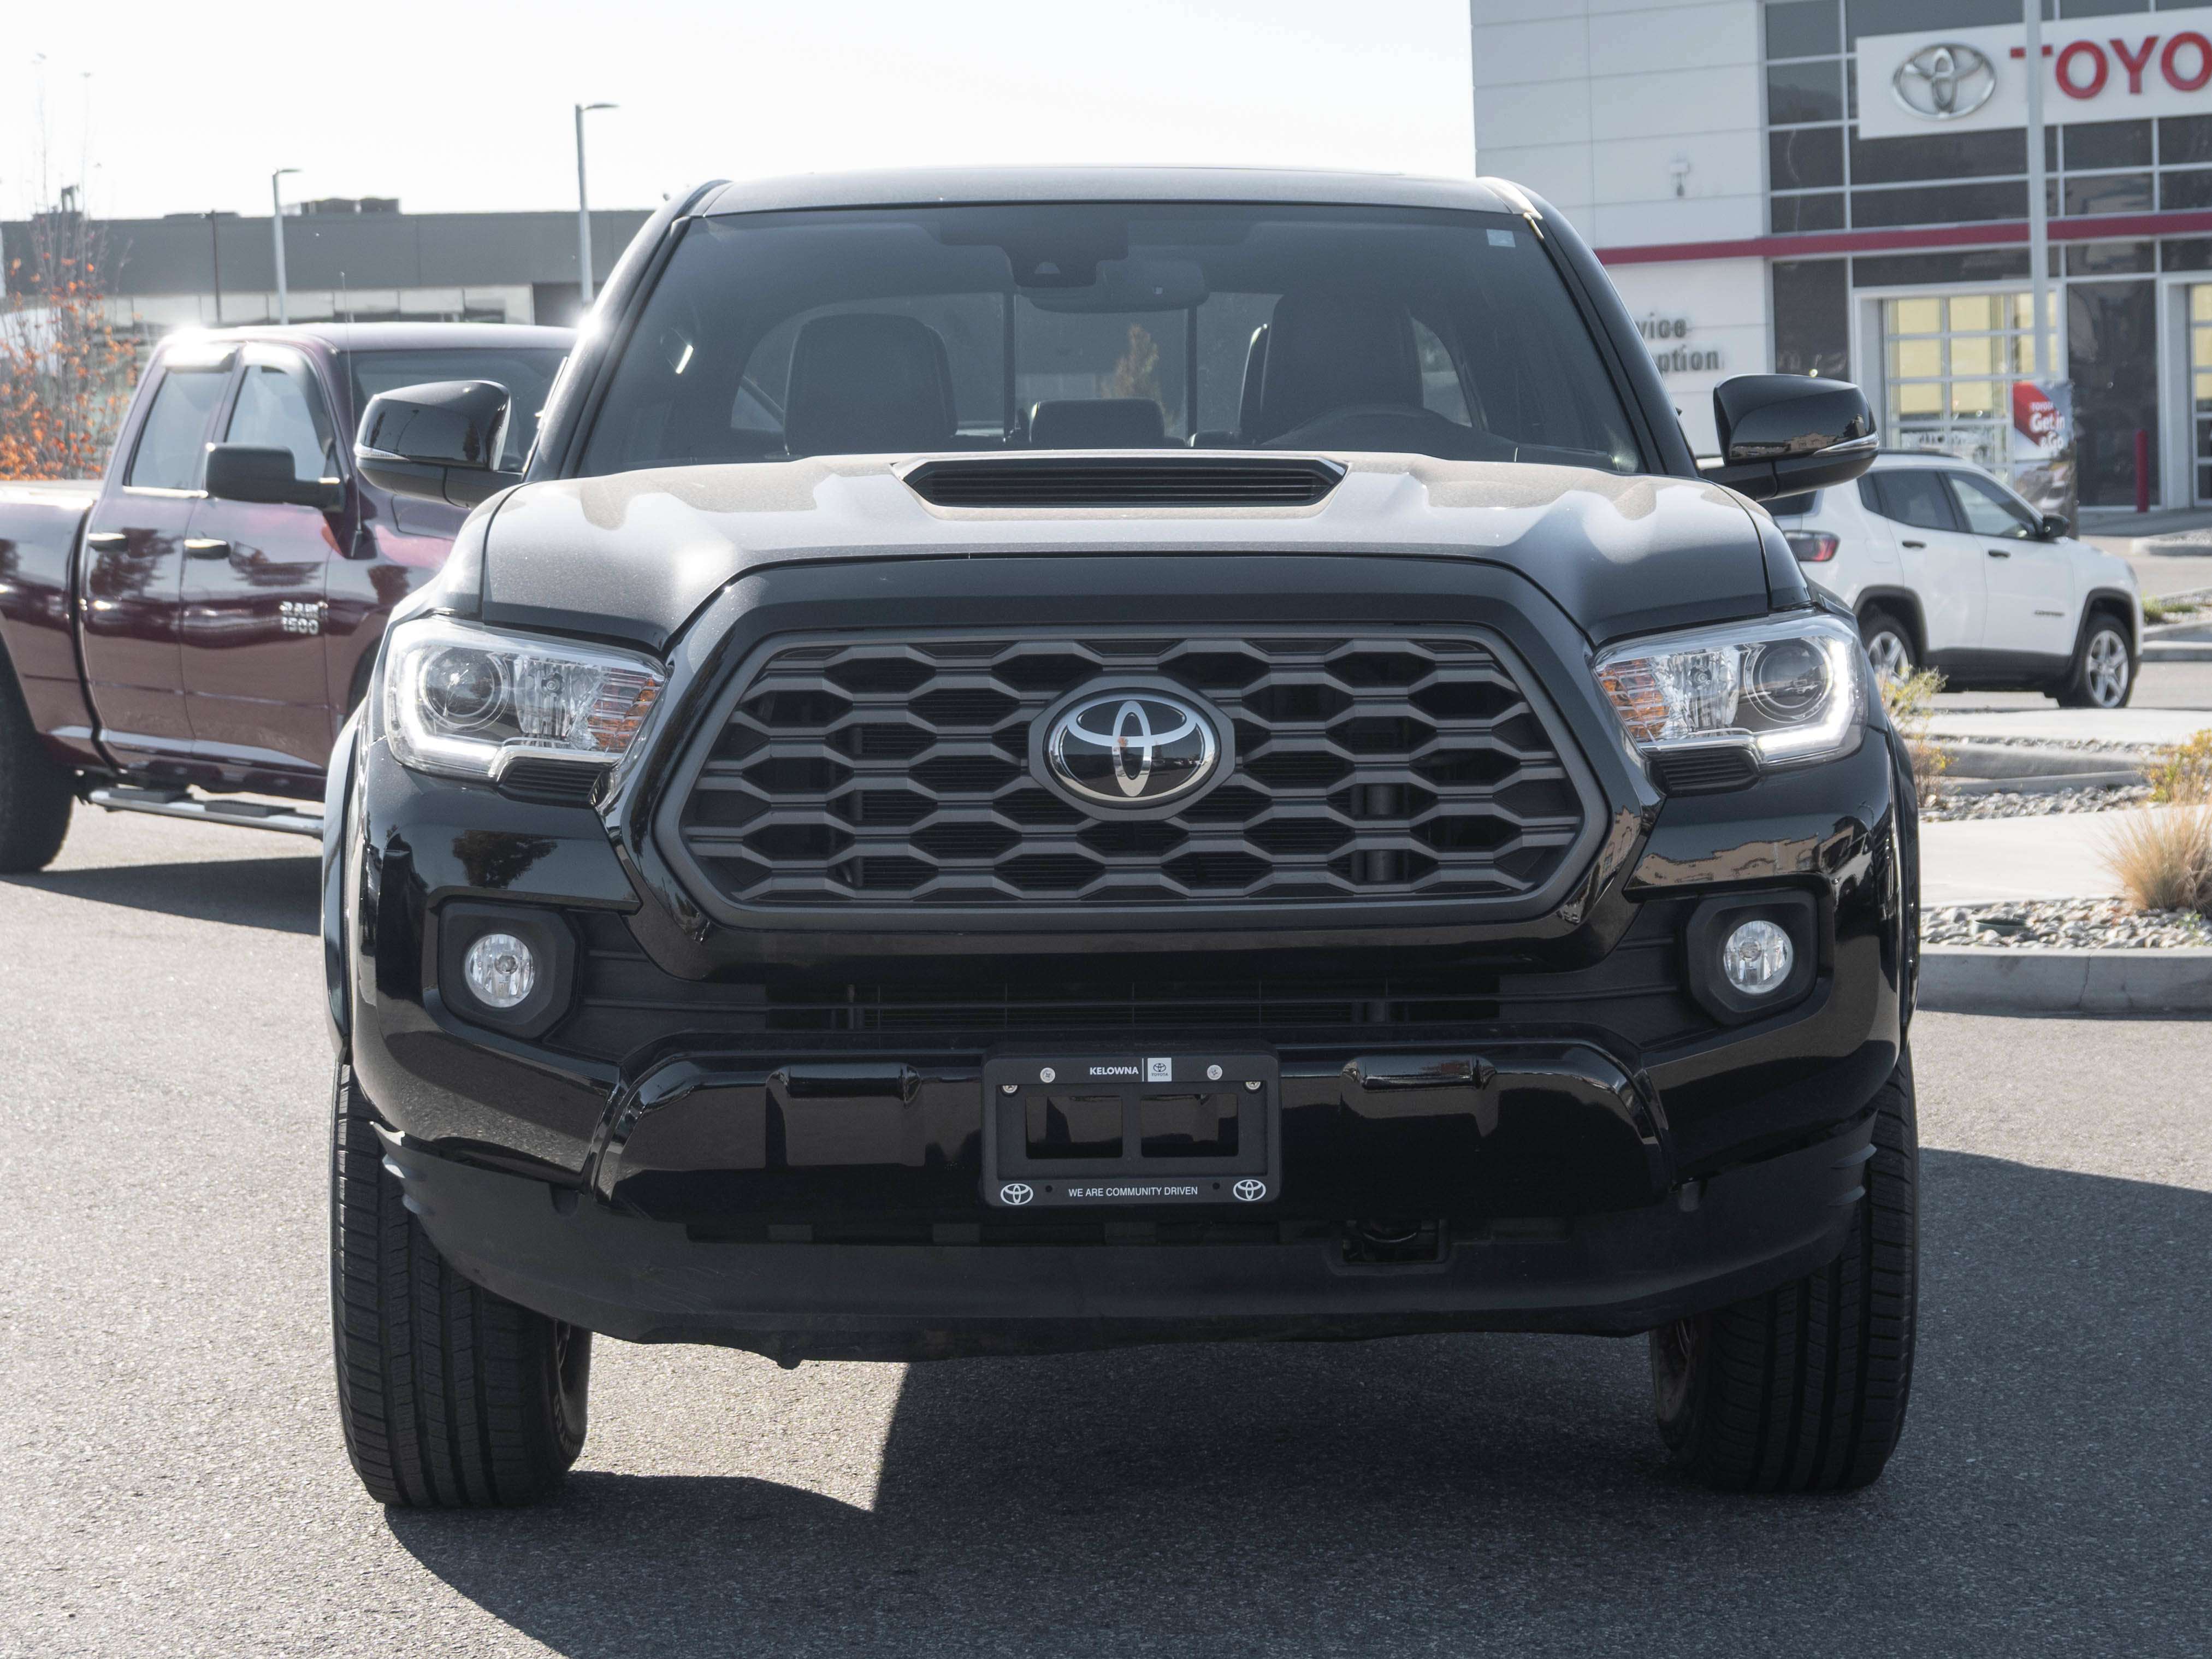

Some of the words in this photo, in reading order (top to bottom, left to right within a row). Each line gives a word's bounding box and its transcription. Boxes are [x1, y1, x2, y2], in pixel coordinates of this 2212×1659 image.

[2010, 31, 2212, 100] OYO
[2030, 412, 2055, 433] Get
[279, 601, 319, 618] RAM
[281, 617, 319, 635] 1500
[1090, 1066, 1139, 1075] KELOWNA
[1068, 1188, 1083, 1196] WE
[1085, 1188, 1104, 1196] ARE
[1106, 1187, 1162, 1196] COMMUNITY
[1164, 1186, 1198, 1195] DRIVEN
